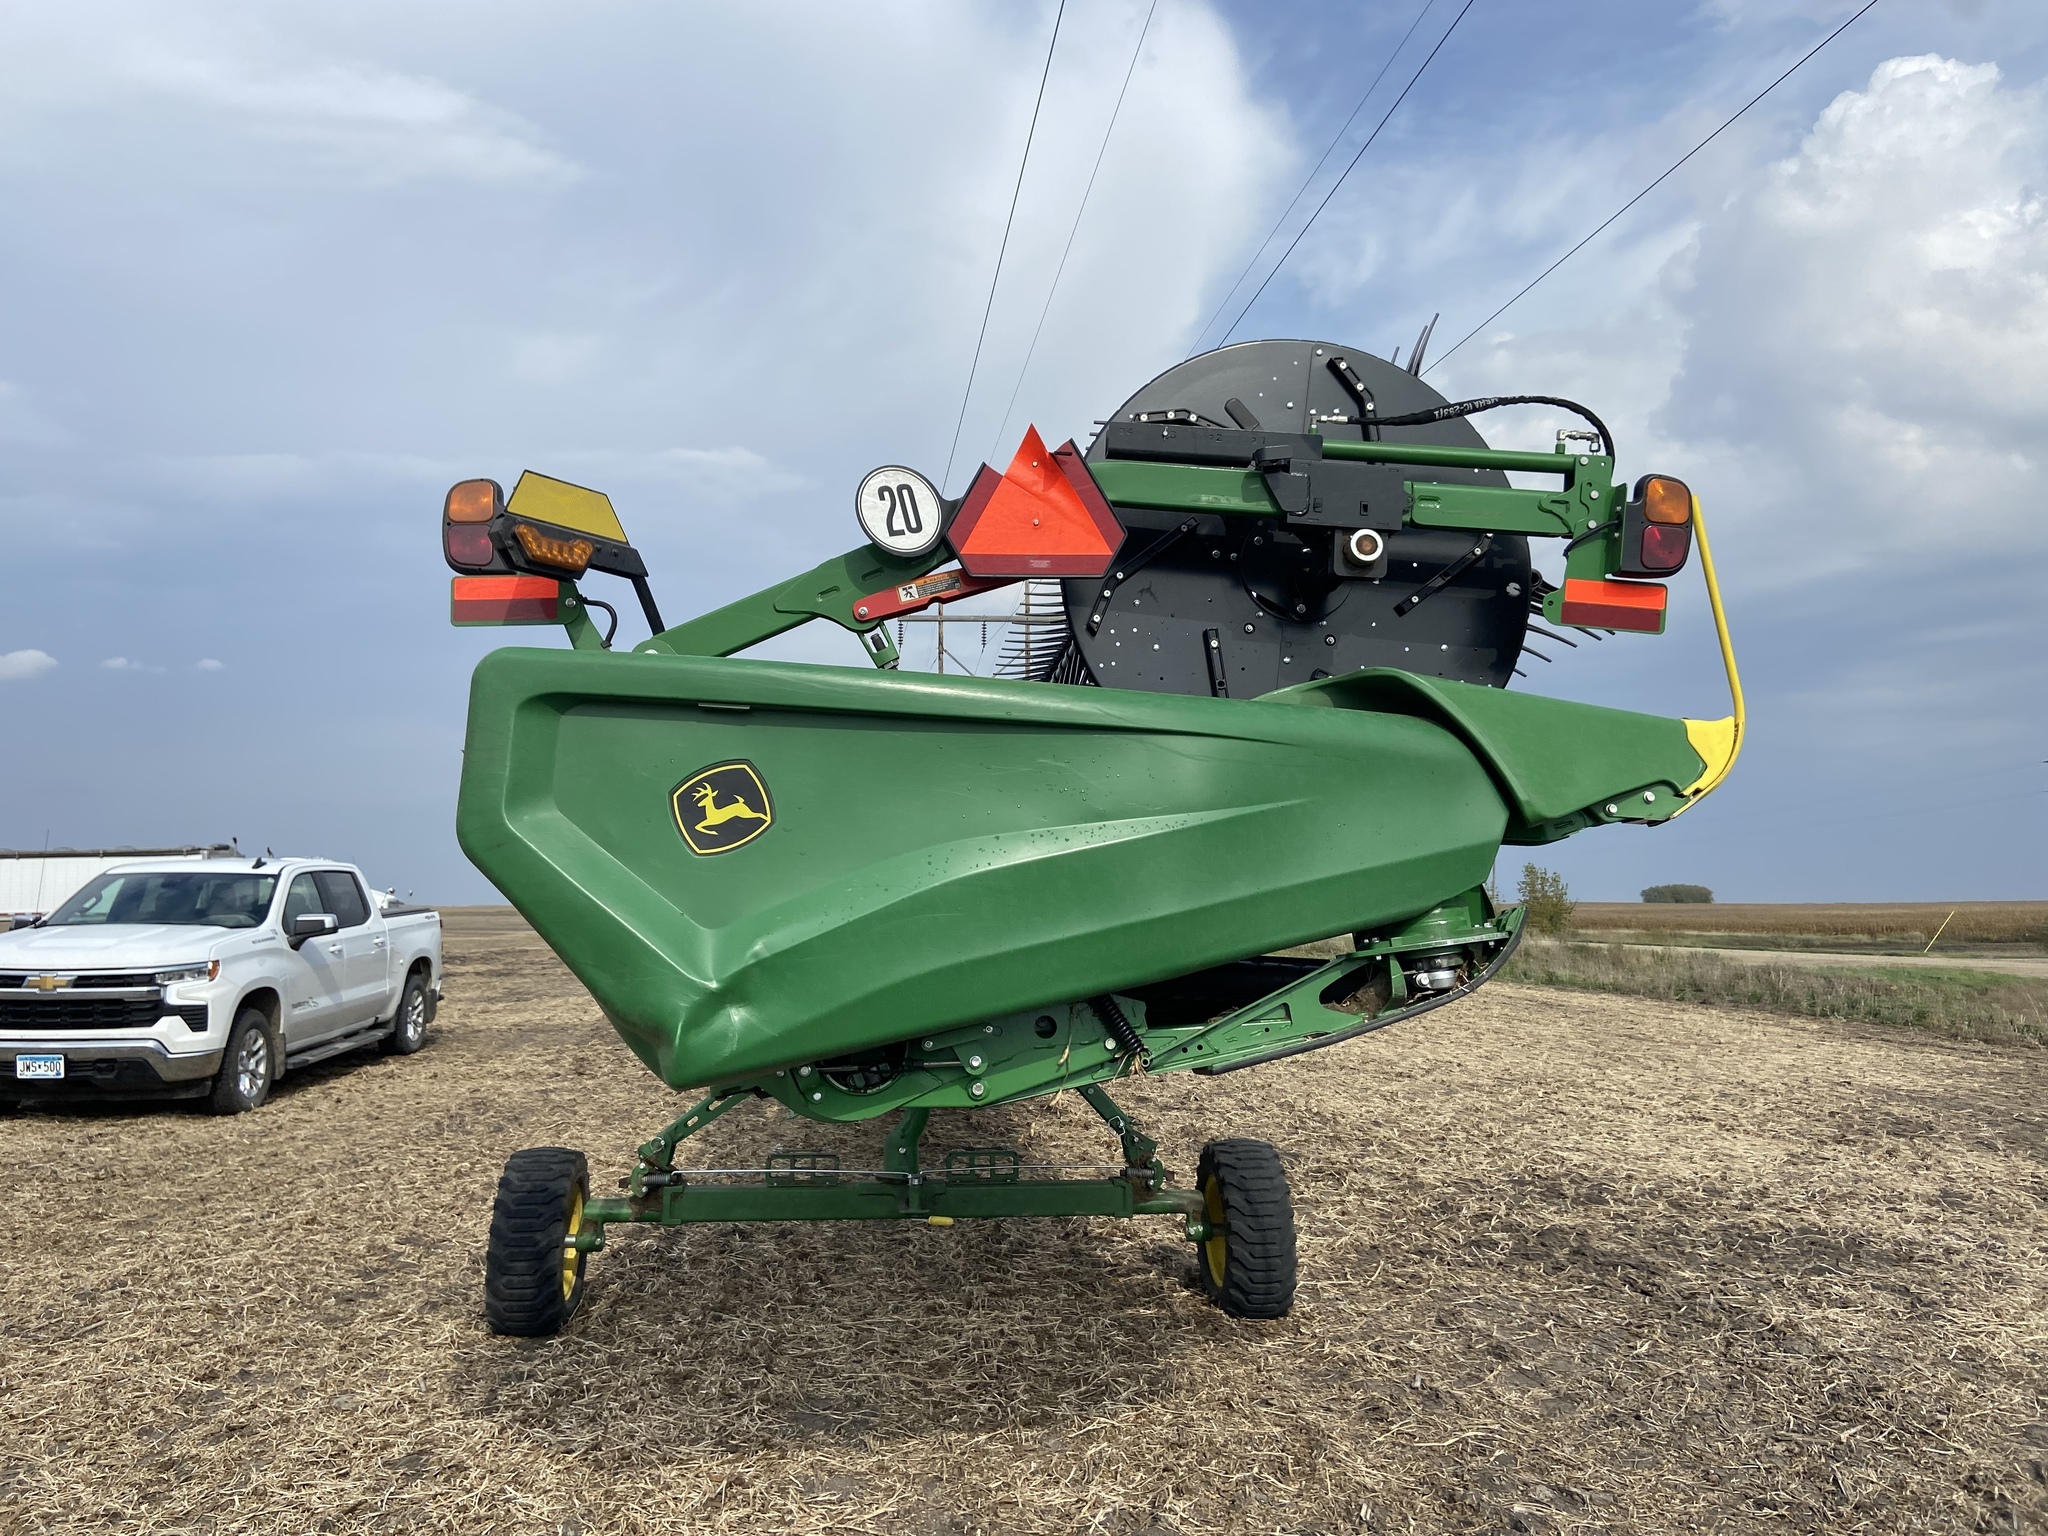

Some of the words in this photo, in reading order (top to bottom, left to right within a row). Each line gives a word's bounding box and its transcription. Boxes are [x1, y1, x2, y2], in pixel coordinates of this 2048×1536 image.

[878, 484, 923, 537] 20
[20, 1060, 37, 1073] JWS
[43, 1060, 61, 1073] 500
